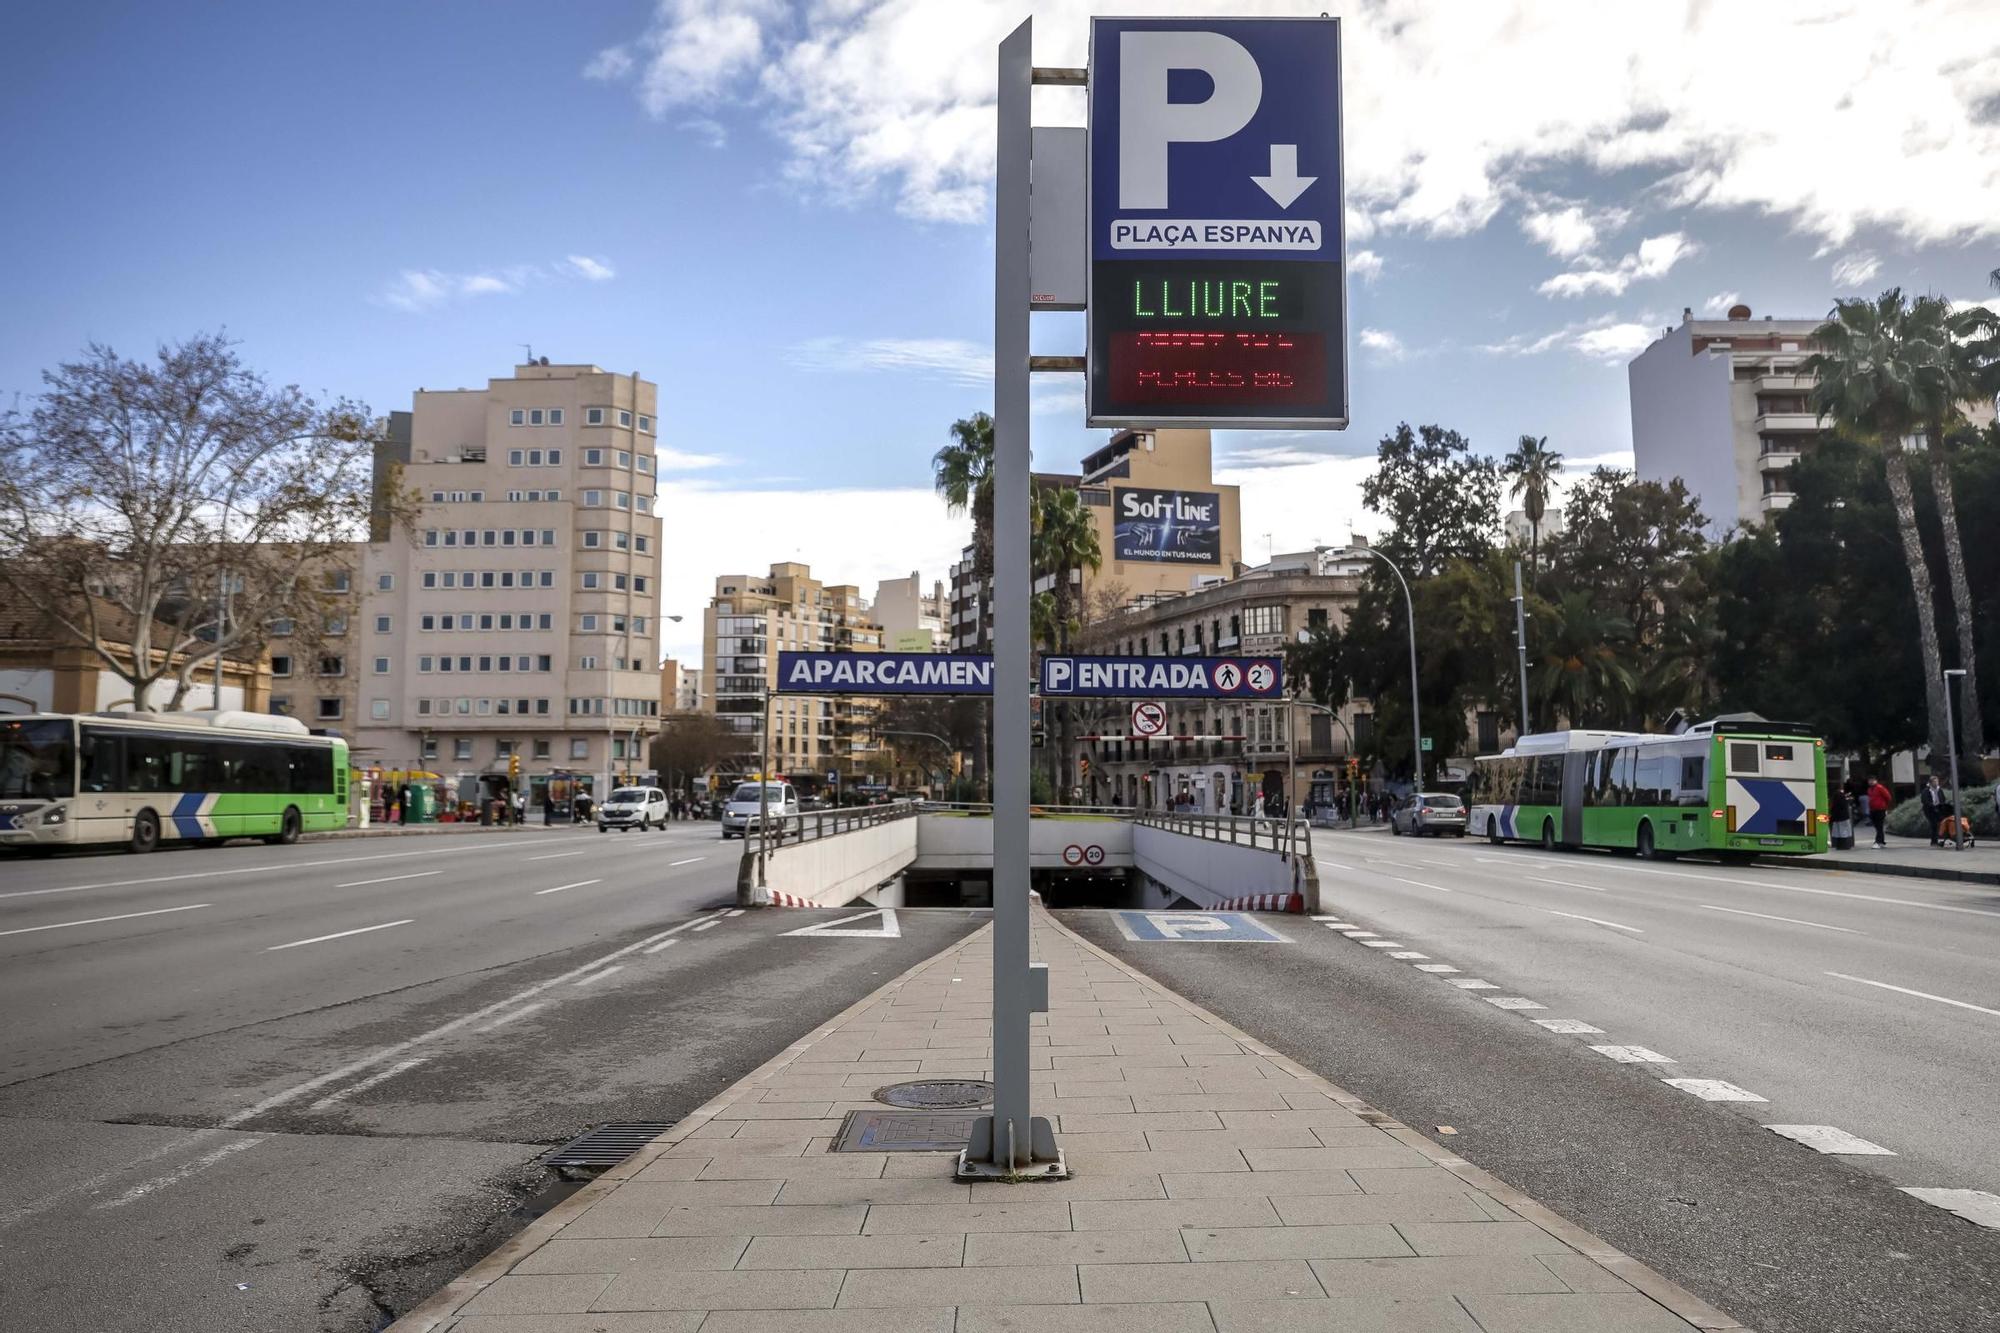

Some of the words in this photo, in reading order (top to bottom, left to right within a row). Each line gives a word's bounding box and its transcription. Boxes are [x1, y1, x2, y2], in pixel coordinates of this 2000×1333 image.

[1119, 31, 1263, 210] P
[1116, 224, 1196, 247] PLAÇA
[1204, 225, 1315, 244] ESPANYA
[1135, 280, 1279, 317] LLIURE
[1171, 551, 1186, 559] TUS
[1186, 552, 1212, 560] MANOS
[1049, 661, 1071, 689] P
[1079, 663, 1209, 689] ENTRADA
[1089, 851, 1101, 859] 20
[1144, 914, 1232, 939] P
